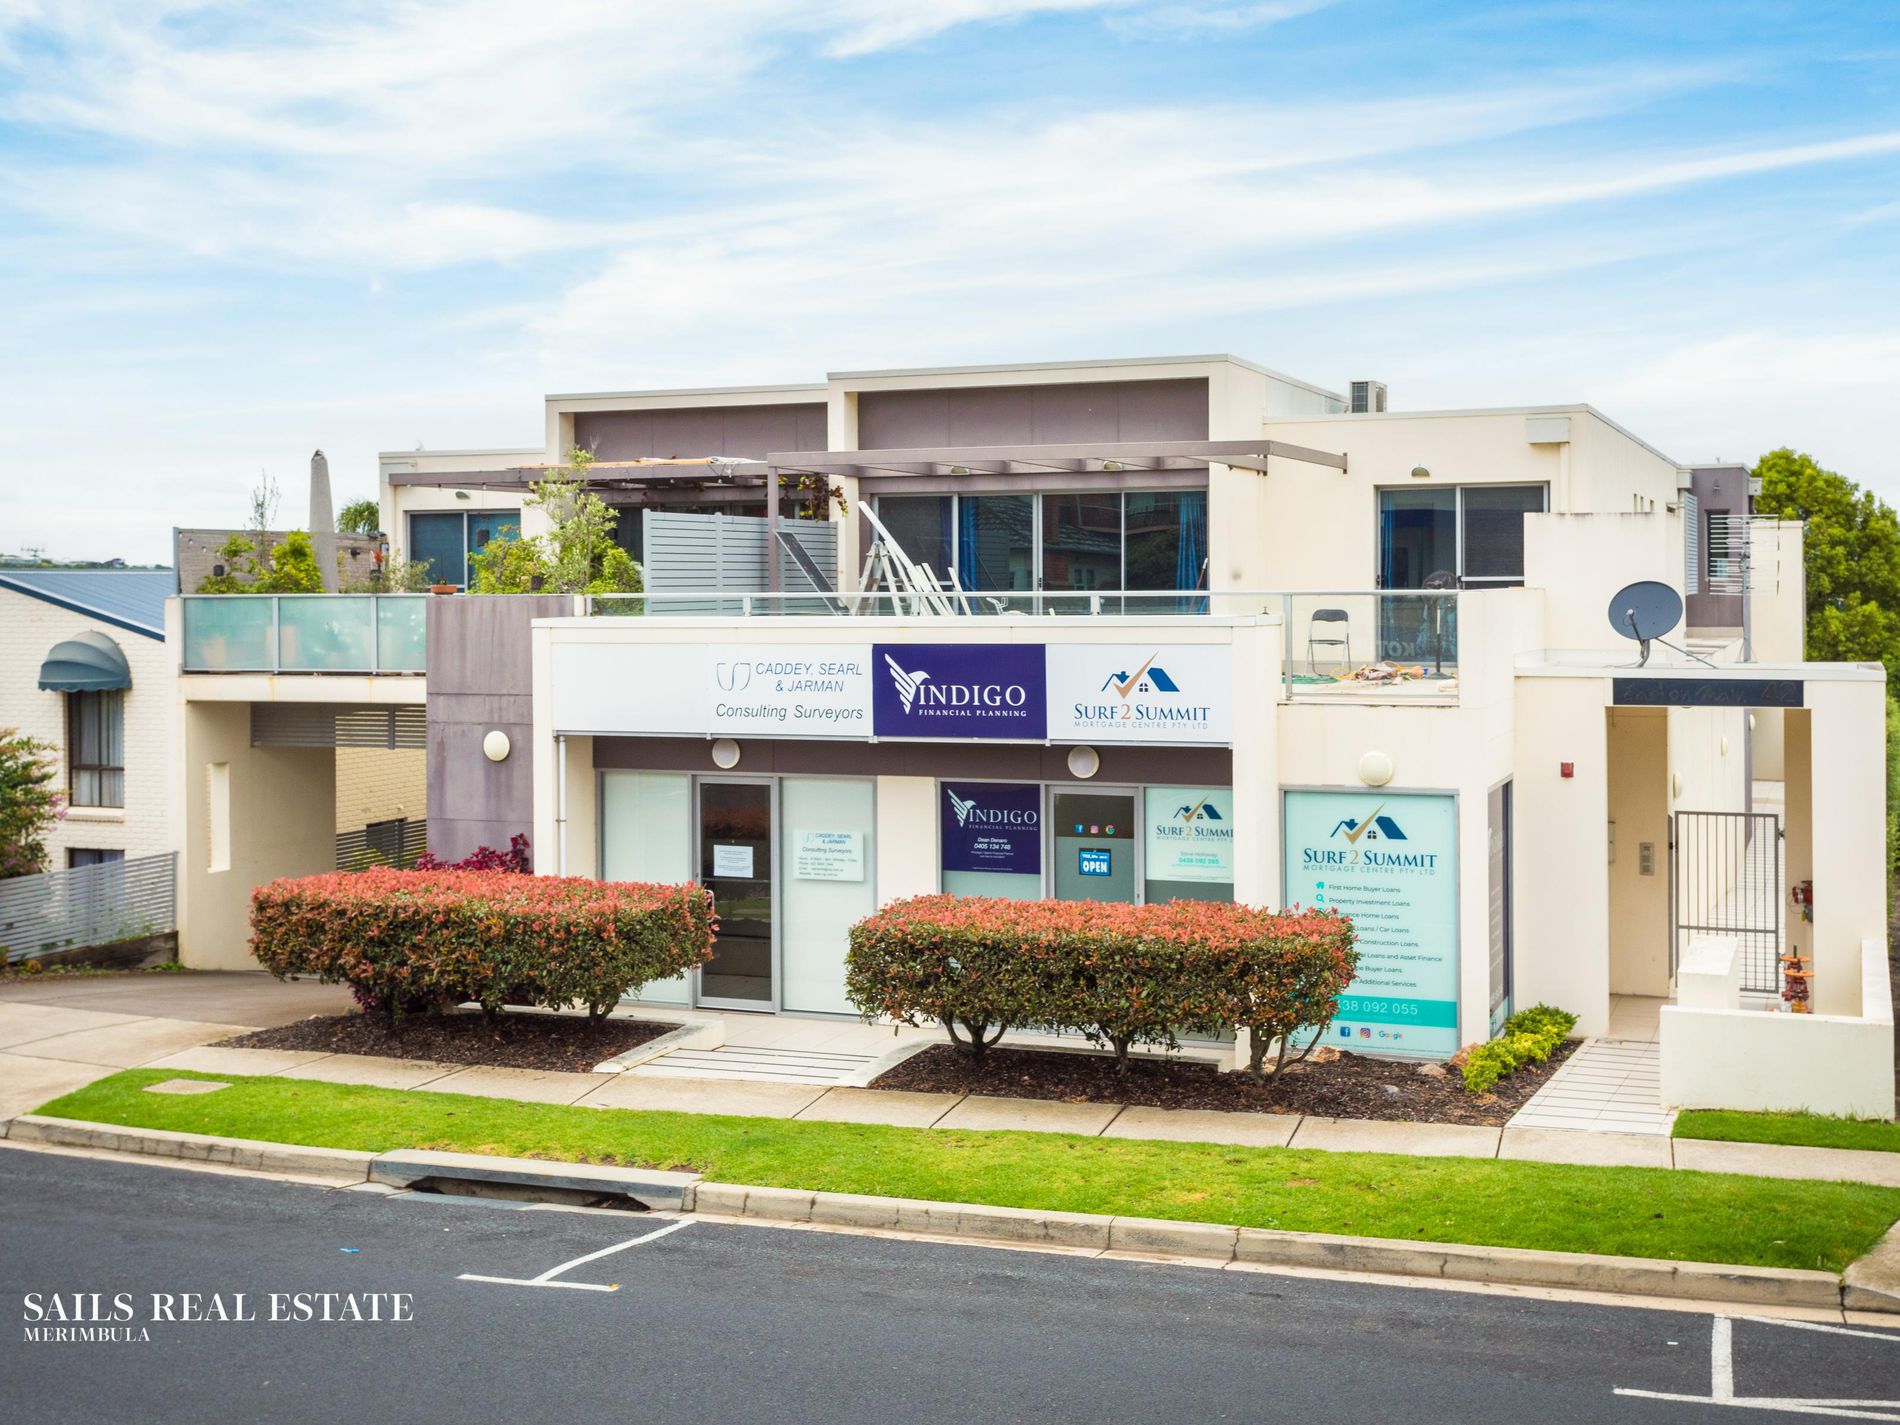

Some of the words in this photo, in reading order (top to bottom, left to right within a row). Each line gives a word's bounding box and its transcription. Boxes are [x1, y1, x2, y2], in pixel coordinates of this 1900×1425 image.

[755, 662, 815, 677] CADDEY,
[818, 662, 863, 676] SEARL
[775, 680, 784, 692] &
[787, 680, 844, 692] JARMAN
[918, 685, 1026, 706] INDIGO
[715, 703, 788, 722] Consulting
[793, 704, 864, 722] Surveyors
[918, 709, 972, 717] FINANCIAL
[976, 709, 1027, 717] PLANNING
[1074, 703, 1118, 720] SURF
[1120, 703, 1131, 720] 2
[1135, 703, 1211, 721] SUMMIT
[1073, 721, 1127, 729] MORTGAGE
[1131, 721, 1167, 729] CENTRE
[1192, 722, 1208, 730] LTD
[968, 809, 1037, 824] INDIGO
[1156, 825, 1184, 836] SURF
[1185, 826, 1192, 836] 2
[1194, 826, 1233, 838] SUMMI
[1303, 848, 1347, 864] SURF
[1349, 850, 1359, 865] 2
[1363, 850, 1438, 868] SUMMIT
[1082, 860, 1107, 873] OPEN
[1303, 865, 1355, 873] MORTGAGE
[1360, 866, 1394, 874] CENTRE
[1419, 868, 1436, 876] LTD
[1329, 897, 1354, 905] Property
[1417, 954, 1443, 962] Finance
[1365, 965, 1384, 973] Buyer
[1391, 980, 1417, 988] Services
[1338, 999, 1359, 1012] 38
[1362, 1001, 1388, 1014] 092
[1392, 1003, 1418, 1015] 055
